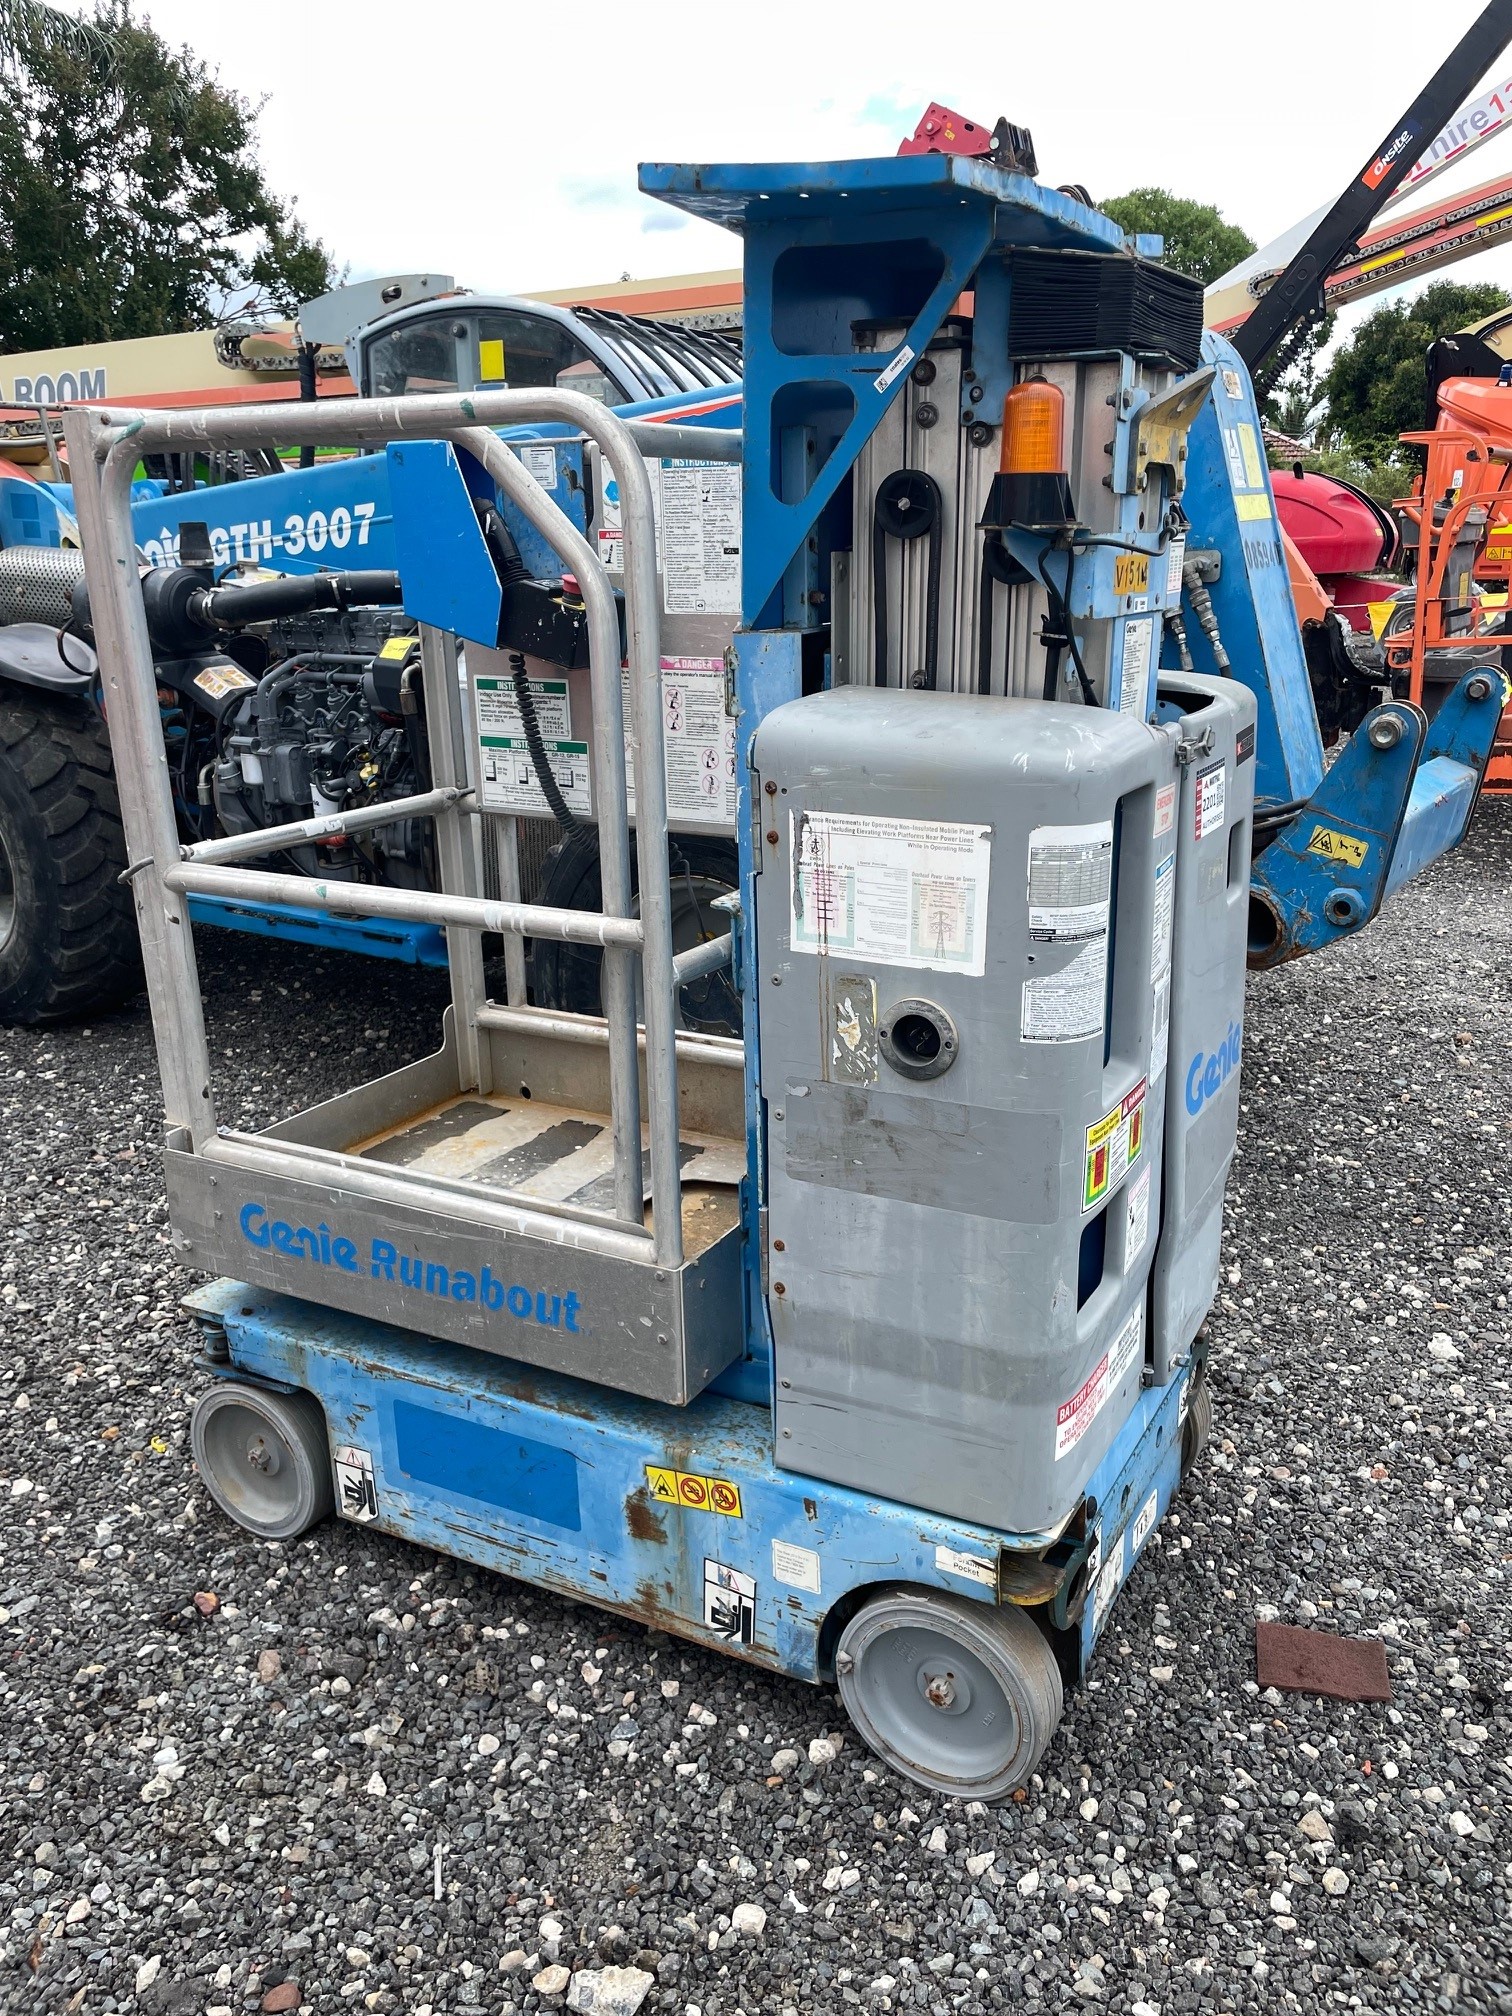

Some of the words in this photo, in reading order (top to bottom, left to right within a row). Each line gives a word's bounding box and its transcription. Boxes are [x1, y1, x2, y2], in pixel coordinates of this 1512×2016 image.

[14, 368, 106, 403] BOOM
[212, 502, 376, 564] GTH-3007
[682, 659, 712, 670] DANGER
[825, 817, 862, 827] Requirements
[871, 820, 899, 831] Operating
[899, 823, 939, 834] Non-Insulated
[939, 827, 959, 835] Mobile
[959, 828, 975, 836] Plant
[831, 825, 856, 835] Including
[857, 828, 882, 837] Elevating
[882, 829, 897, 838] Work
[897, 831, 925, 841] Platforms
[925, 833, 940, 841] Near
[940, 834, 958, 843] Power
[907, 841, 922, 849] While
[930, 844, 958, 854] Operating
[957, 846, 974, 854] Mode
[239, 1202, 360, 1274] Genie
[372, 1237, 582, 1333] Runabout
[1059, 1382, 1090, 1422] BATTERY
[953, 1562, 980, 1578] Pocket
